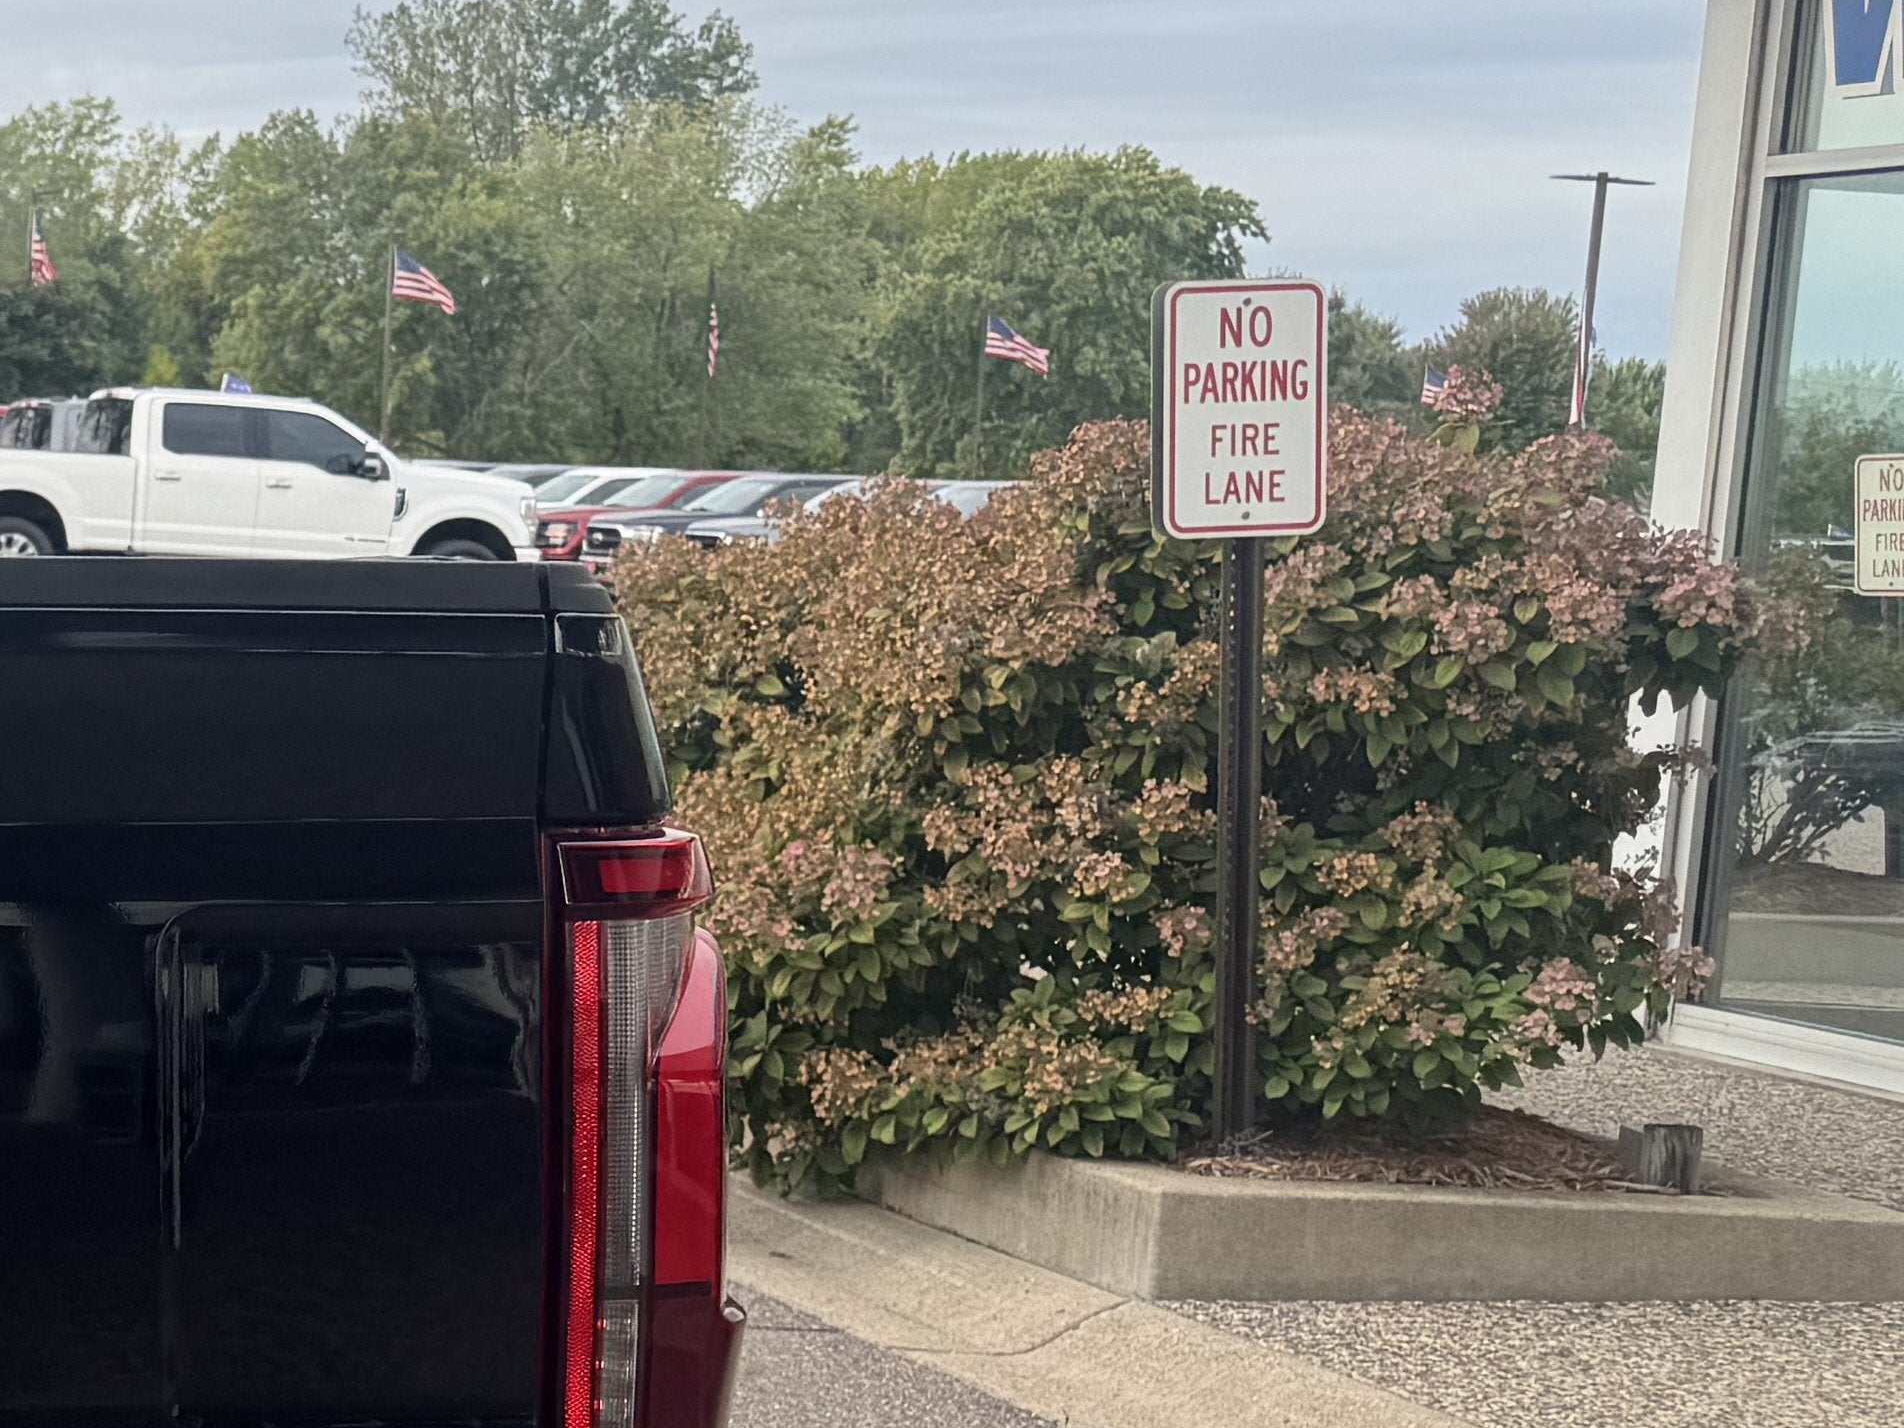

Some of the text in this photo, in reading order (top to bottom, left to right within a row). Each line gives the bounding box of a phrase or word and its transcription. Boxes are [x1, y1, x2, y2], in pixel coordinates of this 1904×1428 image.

[1219, 305, 1272, 349] NO
[1183, 359, 1309, 404] PARKING
[1211, 422, 1280, 457] FIRE
[1204, 469, 1285, 505] LANE
[1879, 467, 1904, 492] NO
[1862, 498, 1904, 522] PARKI
[1872, 558, 1904, 577] LAN
